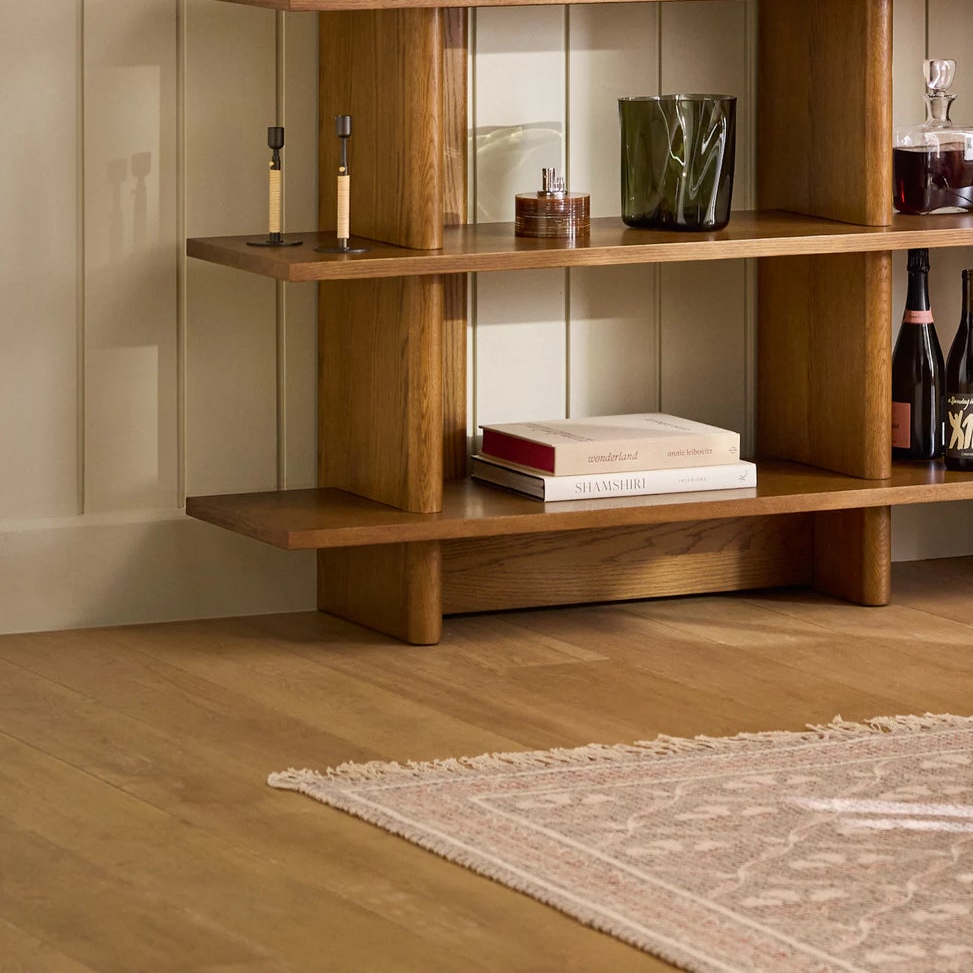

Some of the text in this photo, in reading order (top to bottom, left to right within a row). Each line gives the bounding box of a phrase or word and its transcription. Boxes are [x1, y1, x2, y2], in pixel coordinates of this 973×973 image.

[587, 450, 638, 464] wonderland
[686, 446, 713, 457] leibovitz
[574, 477, 646, 495] SHAMSHIRI
